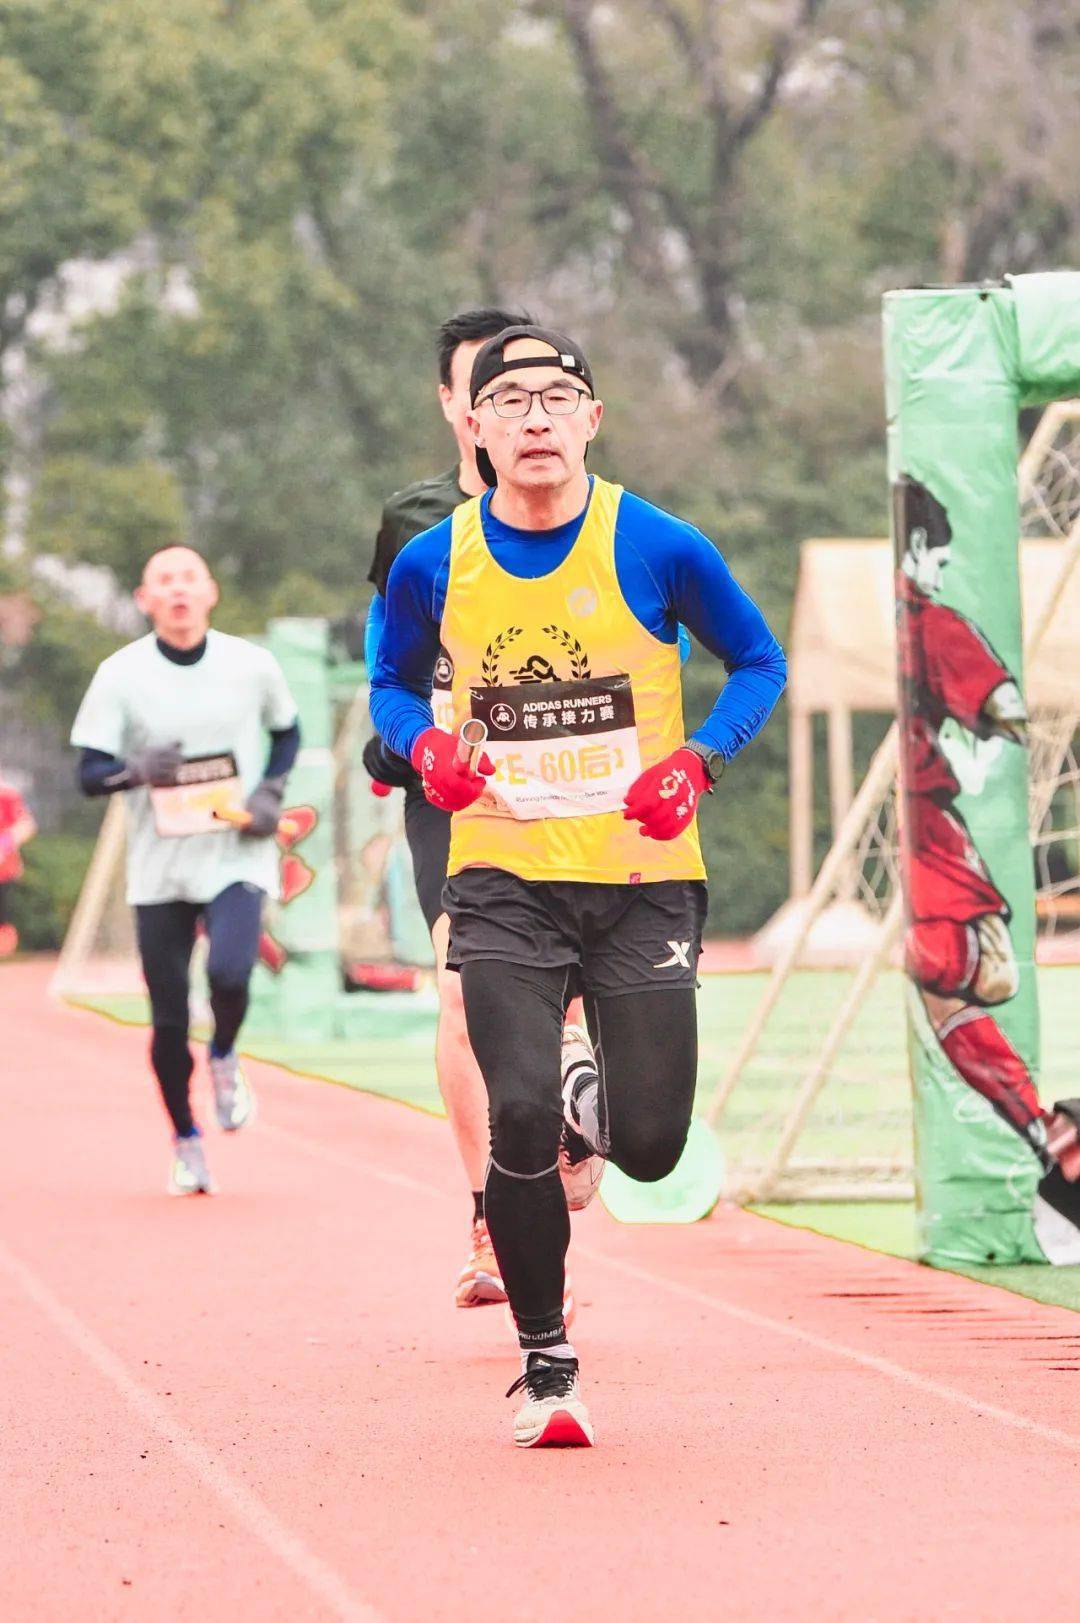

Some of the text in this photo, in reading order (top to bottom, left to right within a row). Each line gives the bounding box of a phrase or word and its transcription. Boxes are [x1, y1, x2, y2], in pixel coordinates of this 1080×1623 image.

[522, 694, 613, 713] ADIDAS RUNNERS
[523, 705, 615, 730] 传承接力赛
